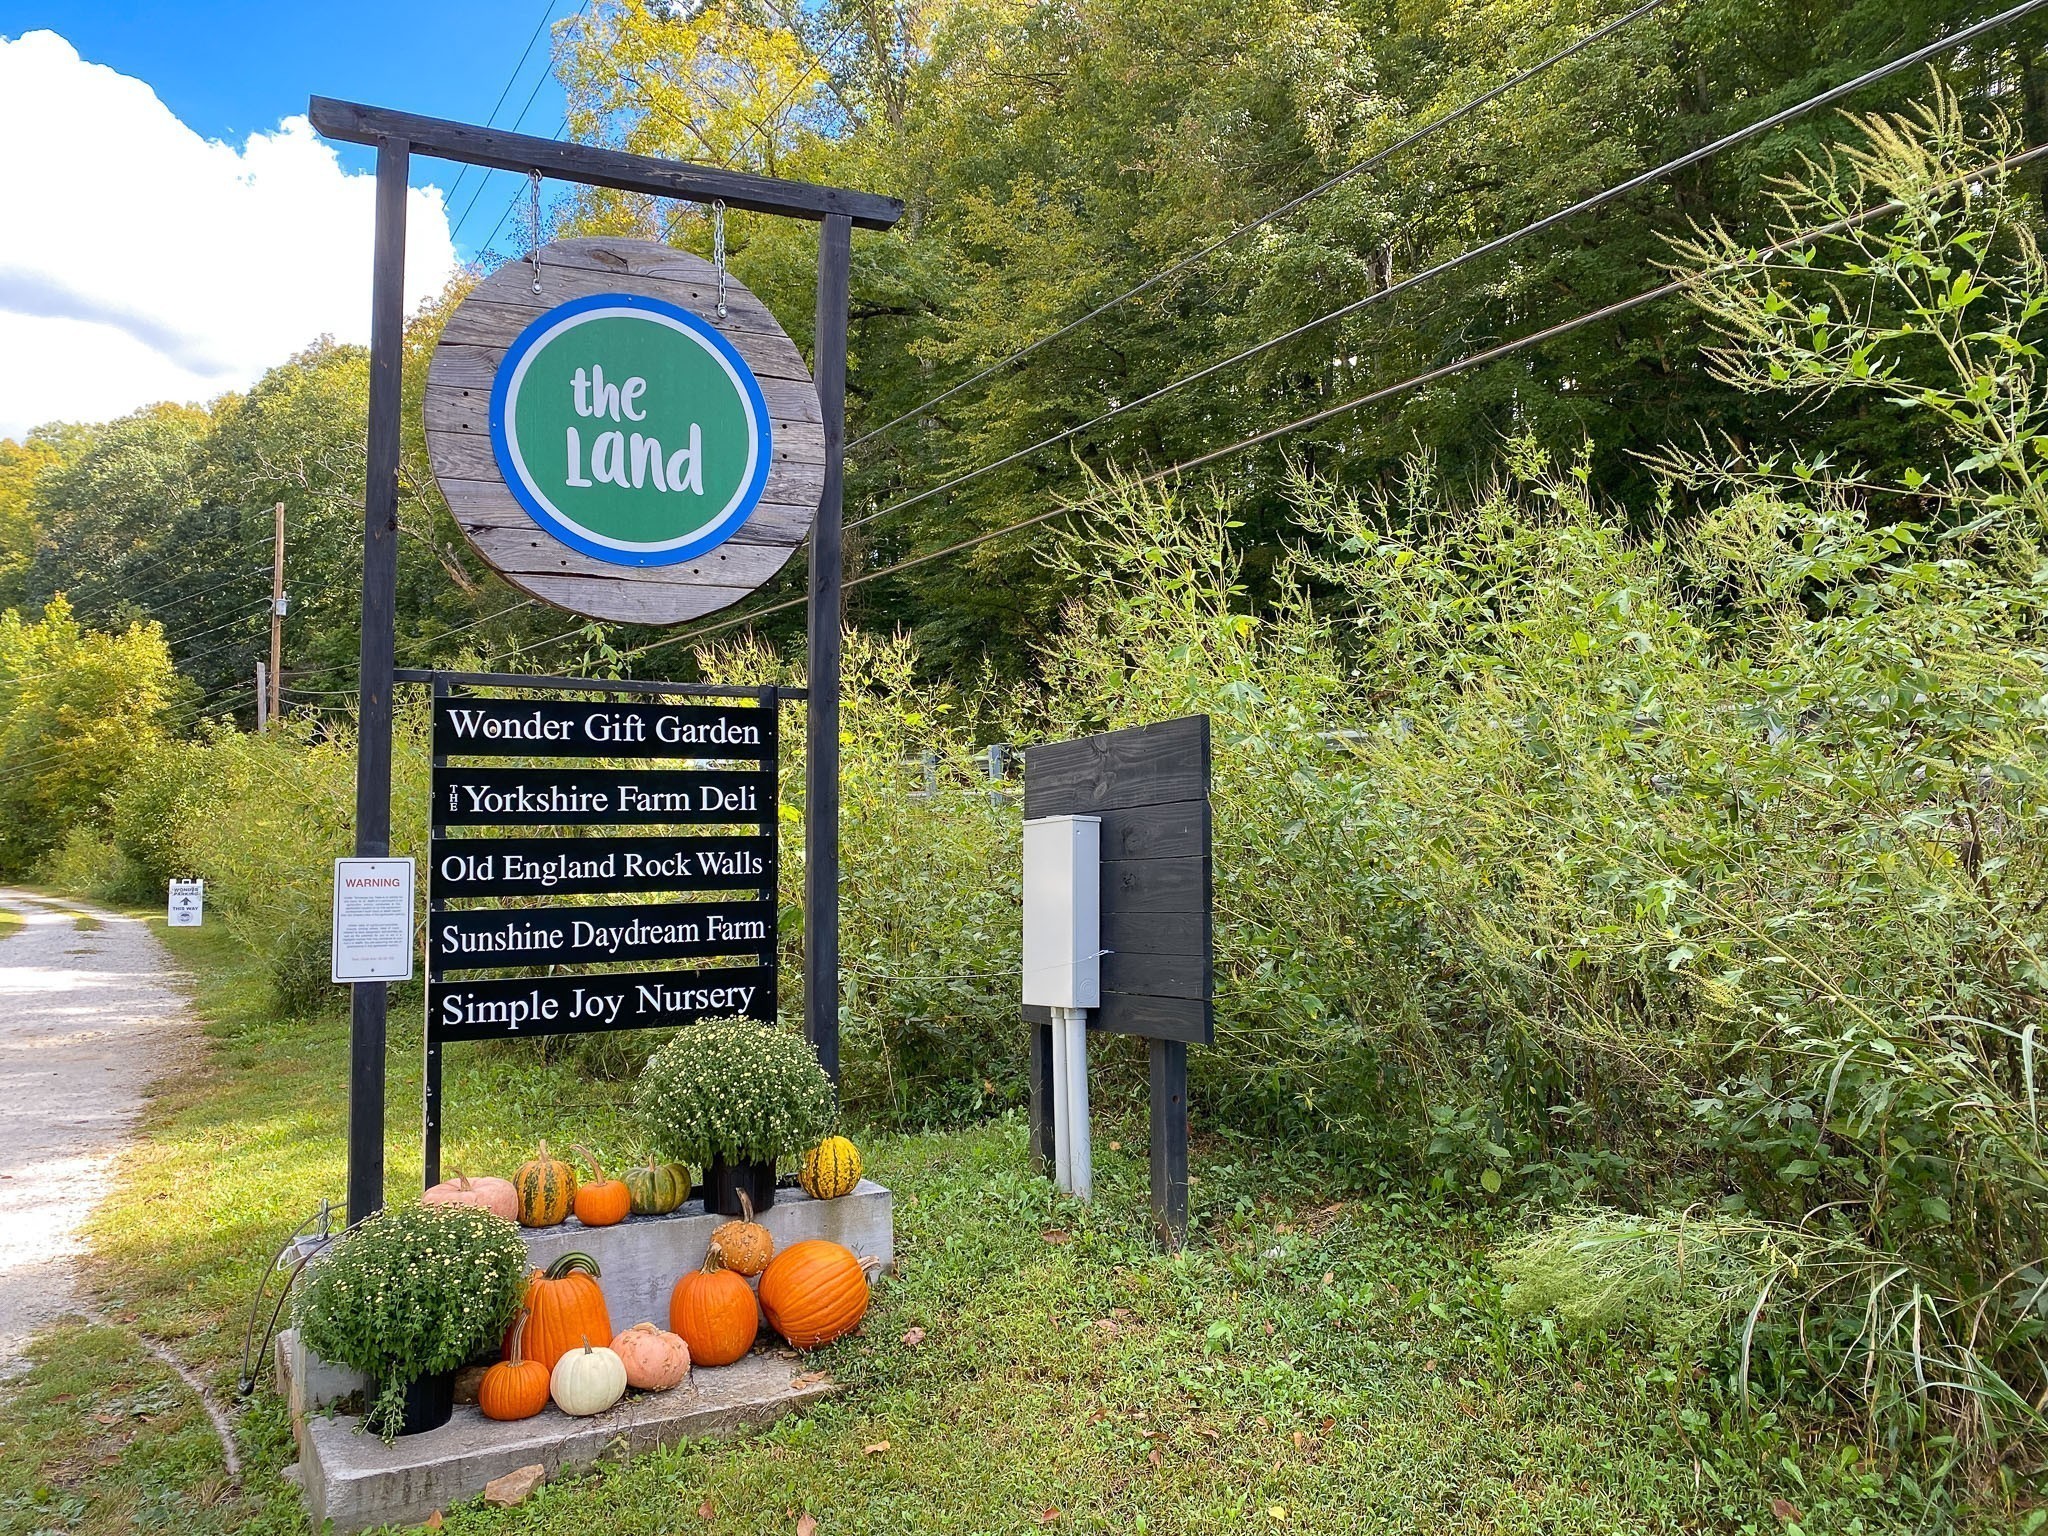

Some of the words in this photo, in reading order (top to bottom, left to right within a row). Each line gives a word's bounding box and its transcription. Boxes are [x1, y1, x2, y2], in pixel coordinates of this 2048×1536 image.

[570, 364, 647, 422] the
[566, 422, 704, 496] Land
[447, 710, 573, 740] Wonder
[585, 714, 645, 742] Gift
[656, 716, 760, 744] Garden
[450, 785, 458, 812] THE
[463, 785, 608, 812] Yorkshire
[617, 786, 691, 811] Farm
[699, 786, 757, 811] Deli
[346, 879, 400, 887] WARNING
[442, 855, 494, 881] Old
[503, 853, 615, 886] England
[624, 853, 691, 877] Rock
[696, 851, 762, 875] Walls
[442, 923, 563, 953] Sunshine
[572, 919, 699, 953] Daydream
[706, 916, 765, 941] Farm
[443, 990, 558, 1029] Simple
[569, 989, 624, 1023] Joy
[636, 984, 755, 1013] Nursery
